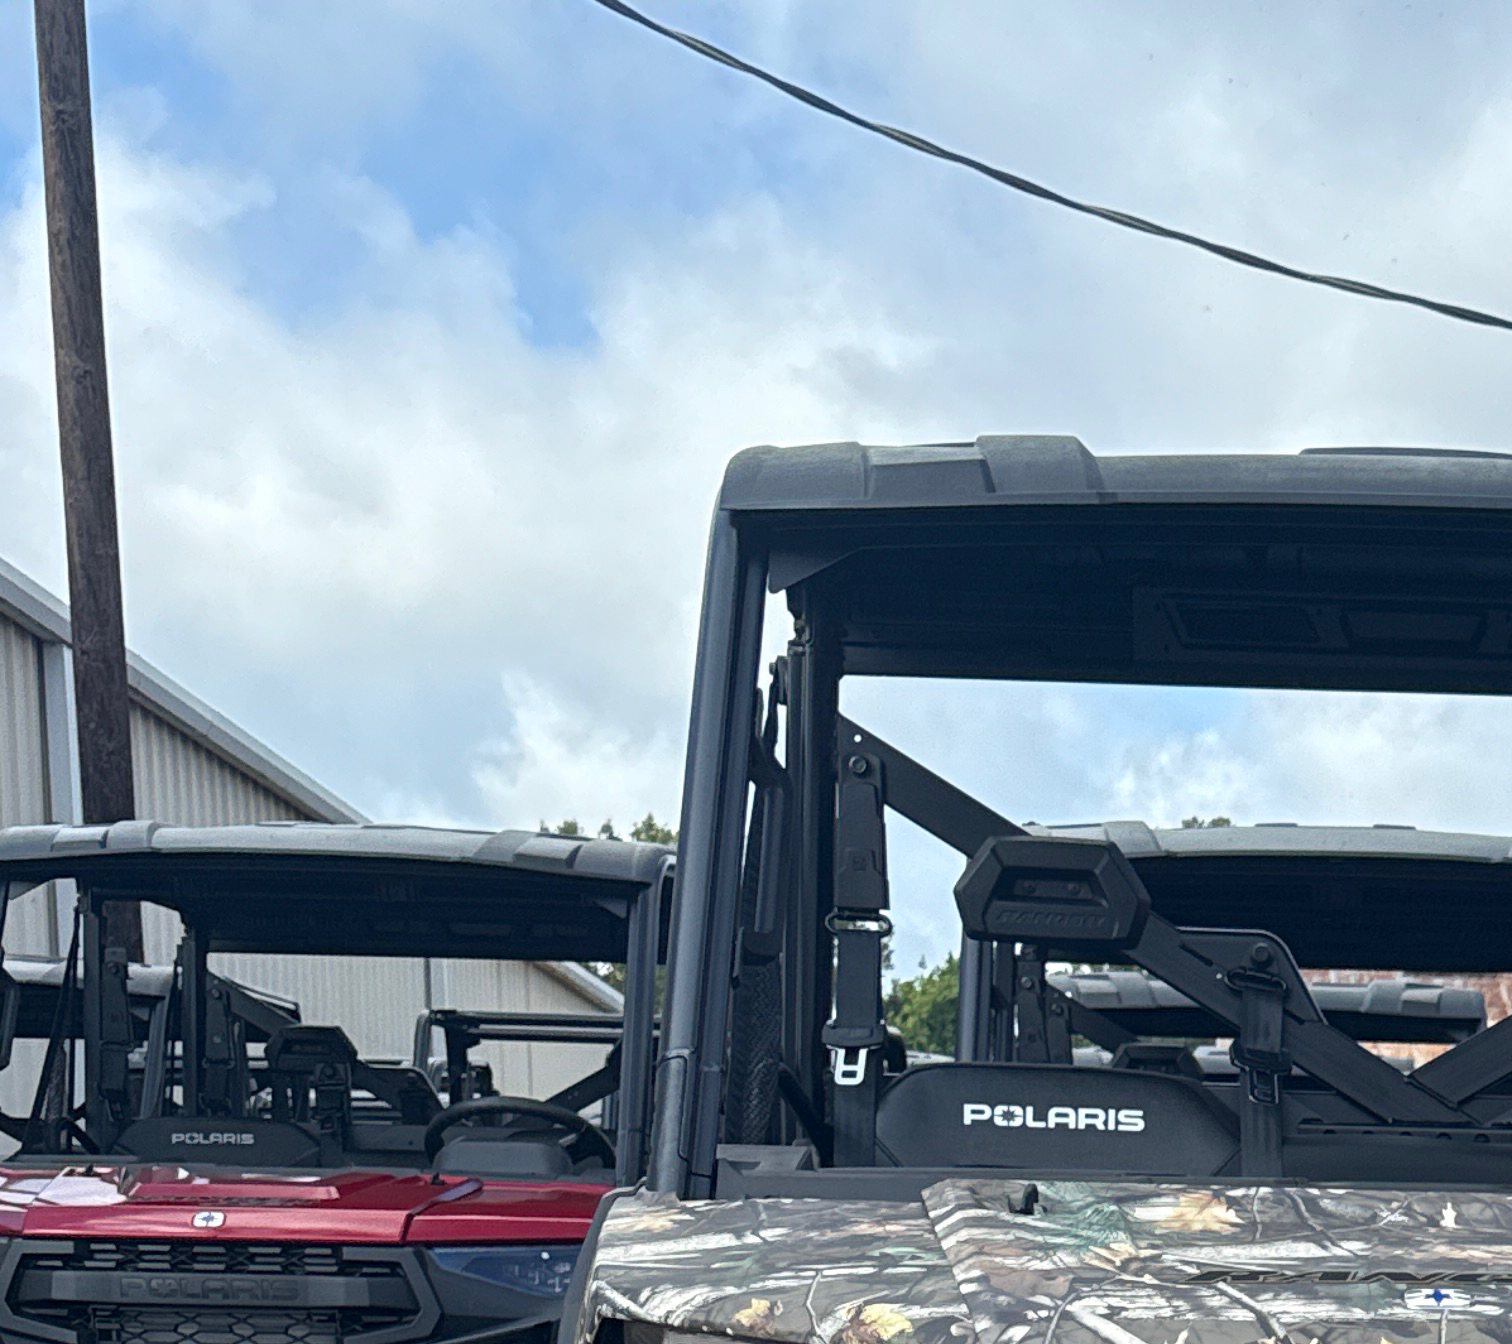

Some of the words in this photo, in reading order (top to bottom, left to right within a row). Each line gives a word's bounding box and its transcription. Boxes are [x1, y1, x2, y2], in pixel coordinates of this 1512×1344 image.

[963, 1103, 1145, 1131] POLARIS
[171, 1132, 255, 1145] POLARIS
[120, 1277, 300, 1301] POLARIS
